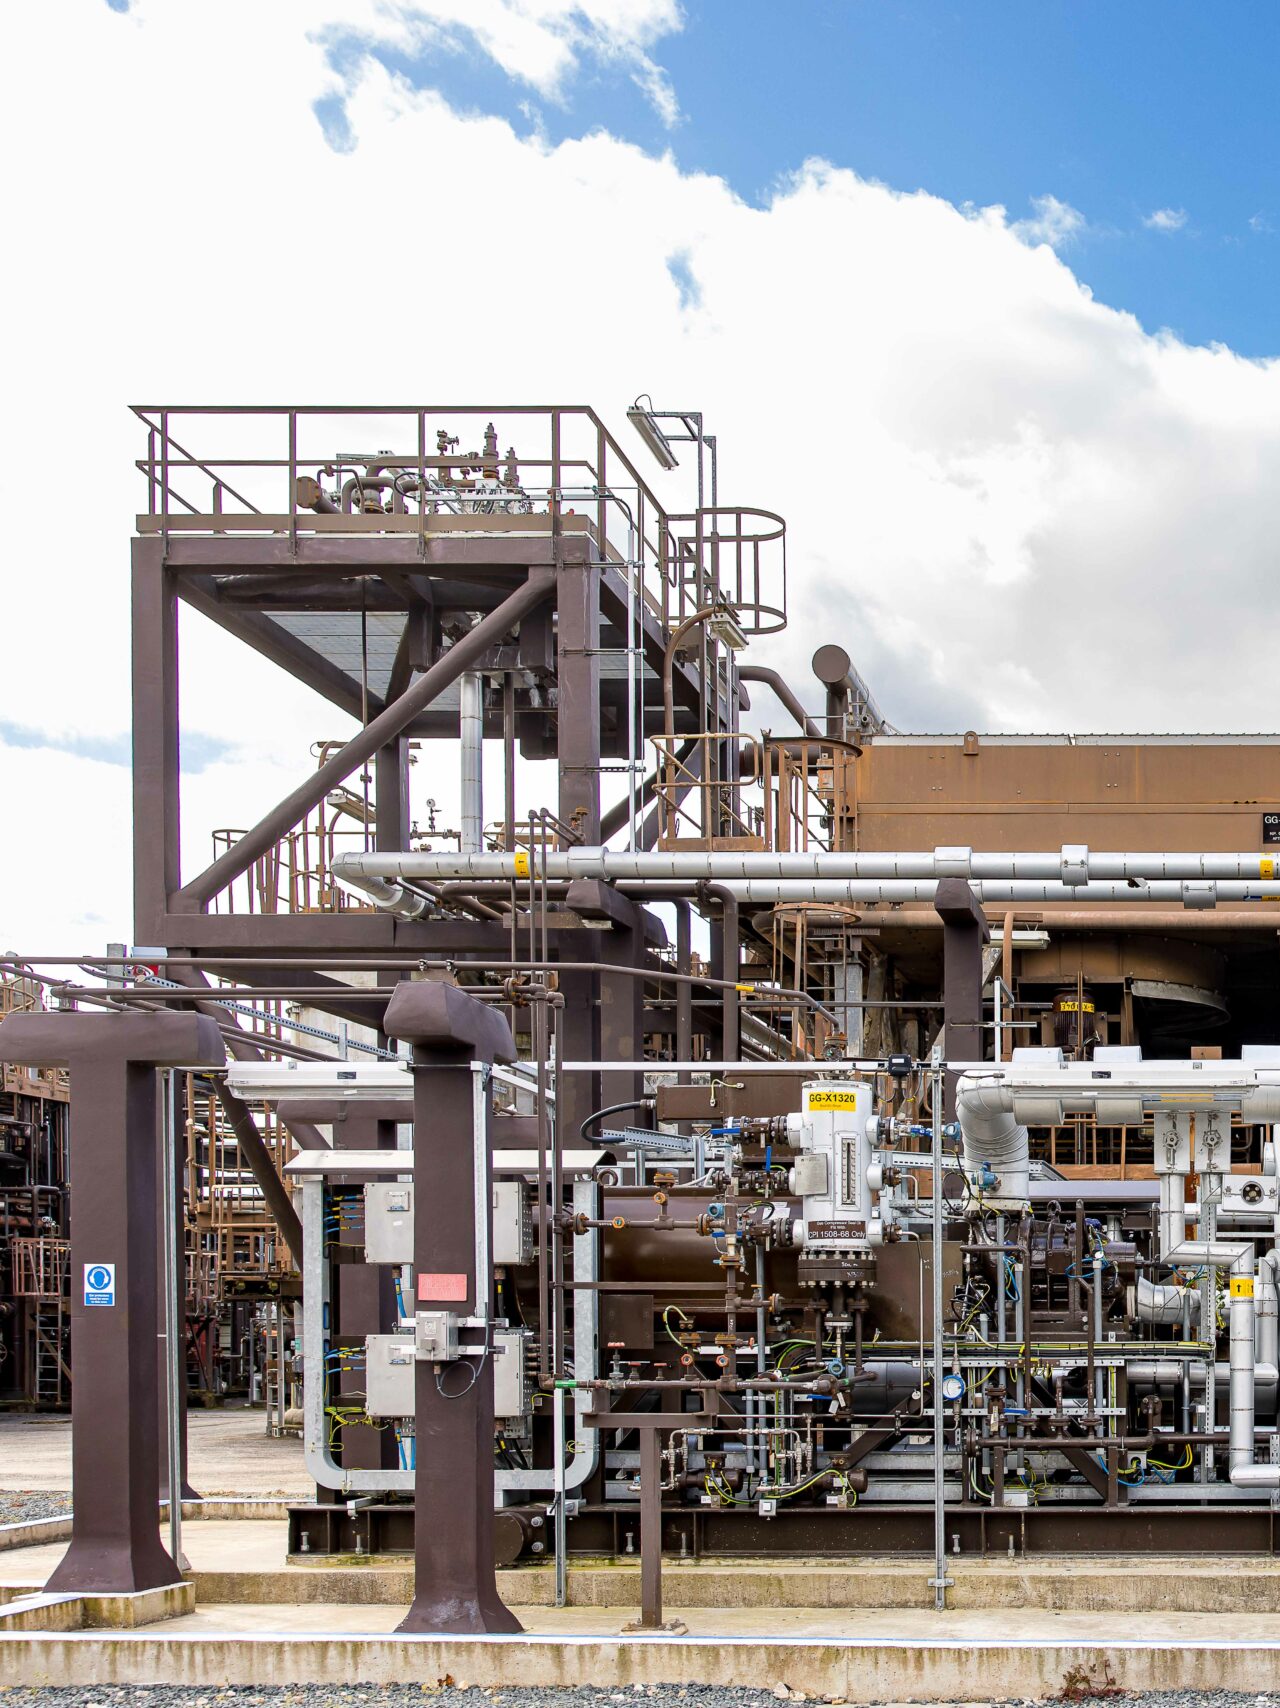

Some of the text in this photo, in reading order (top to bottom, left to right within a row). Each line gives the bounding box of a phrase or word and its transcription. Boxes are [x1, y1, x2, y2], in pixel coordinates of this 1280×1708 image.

[809, 1093, 855, 1103] GG-X1320
[808, 1230, 866, 1239] CPI 1508-68 Only
